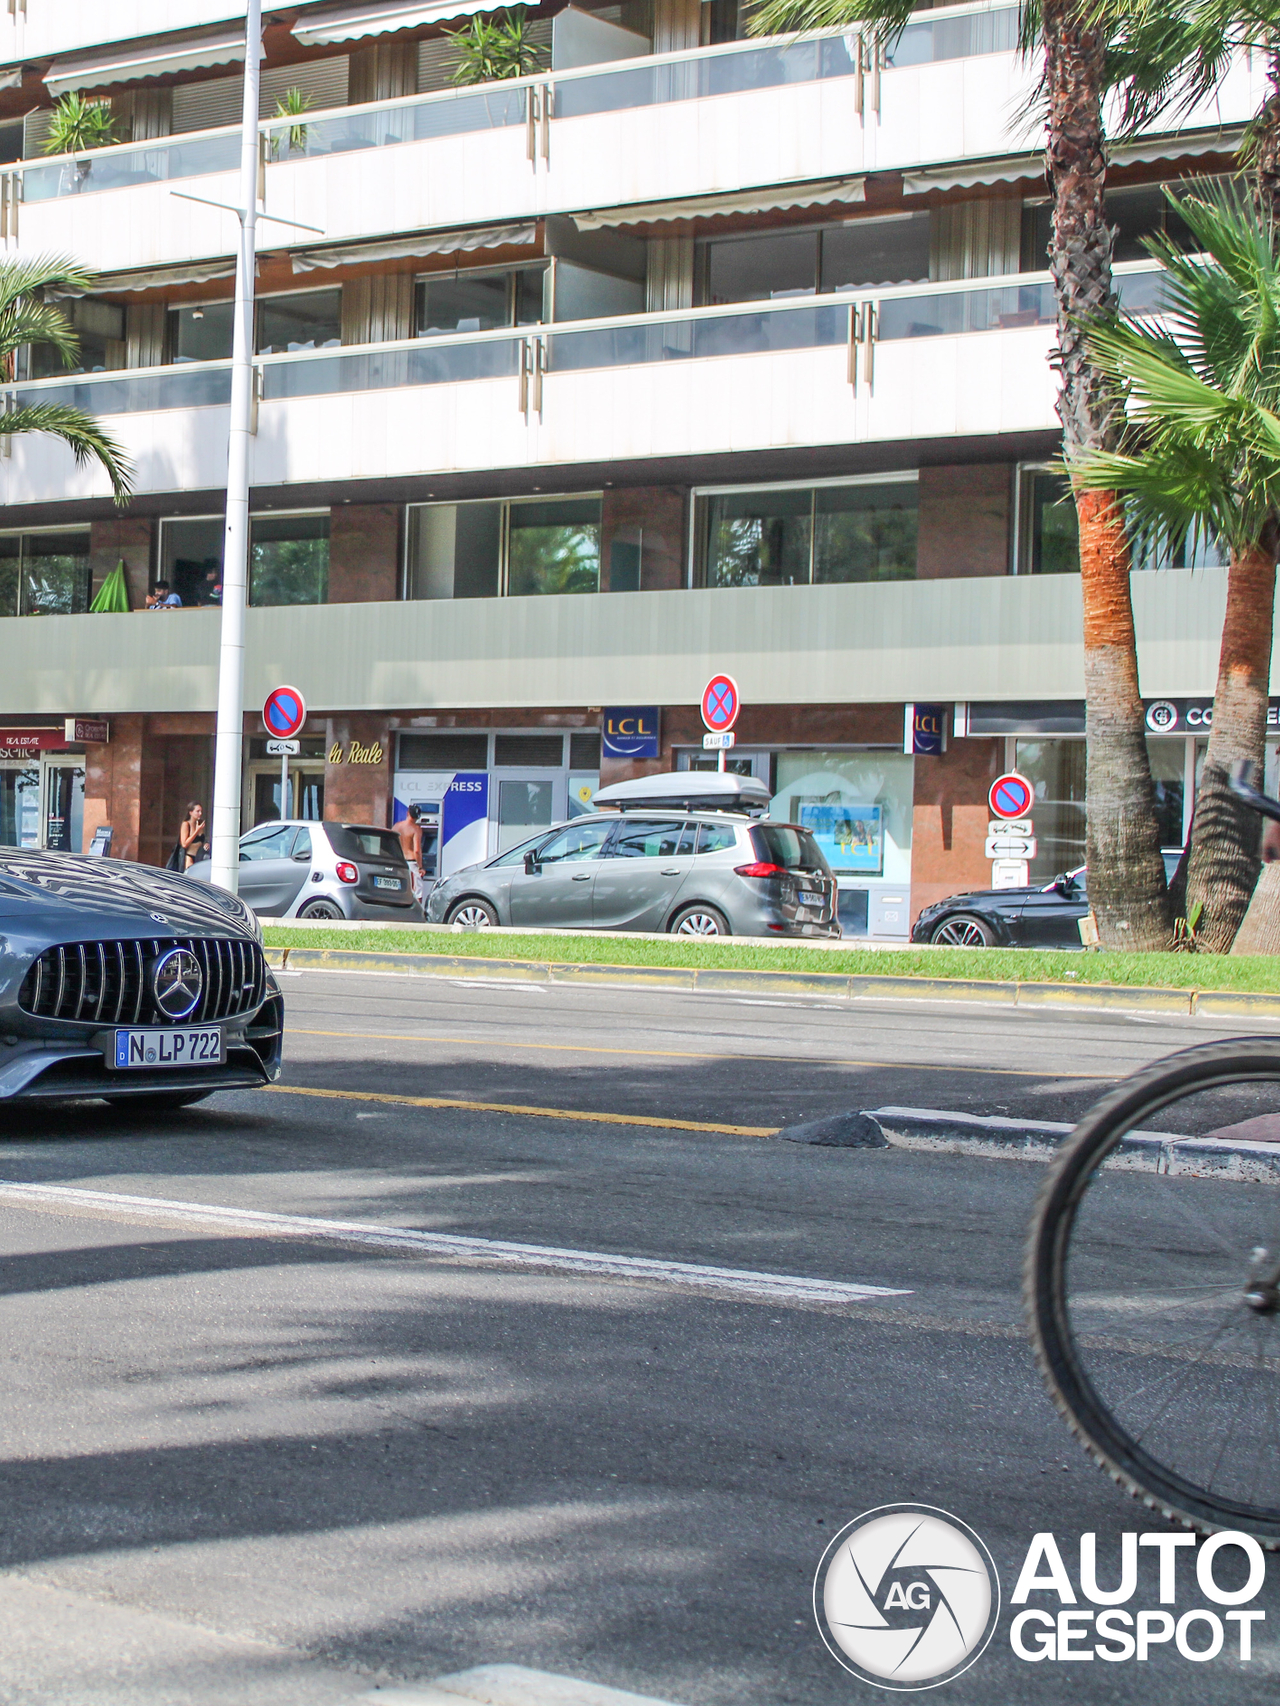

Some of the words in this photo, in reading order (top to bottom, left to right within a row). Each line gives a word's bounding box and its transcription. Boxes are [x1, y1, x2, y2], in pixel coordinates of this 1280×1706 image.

[608, 718, 651, 735] LCL
[915, 715, 939, 733] LCL
[6, 737, 19, 745] REAL
[20, 737, 39, 745] ESTATE
[705, 736, 721, 746] SAUF
[347, 741, 383, 764] Réale
[400, 781, 421, 791] LCL
[427, 781, 482, 792] EXPRESS
[840, 842, 879, 856] LCL
[130, 1034, 144, 1062] N
[159, 1034, 185, 1061] LP
[189, 1032, 219, 1060] 722
[119, 1052, 125, 1060] D
